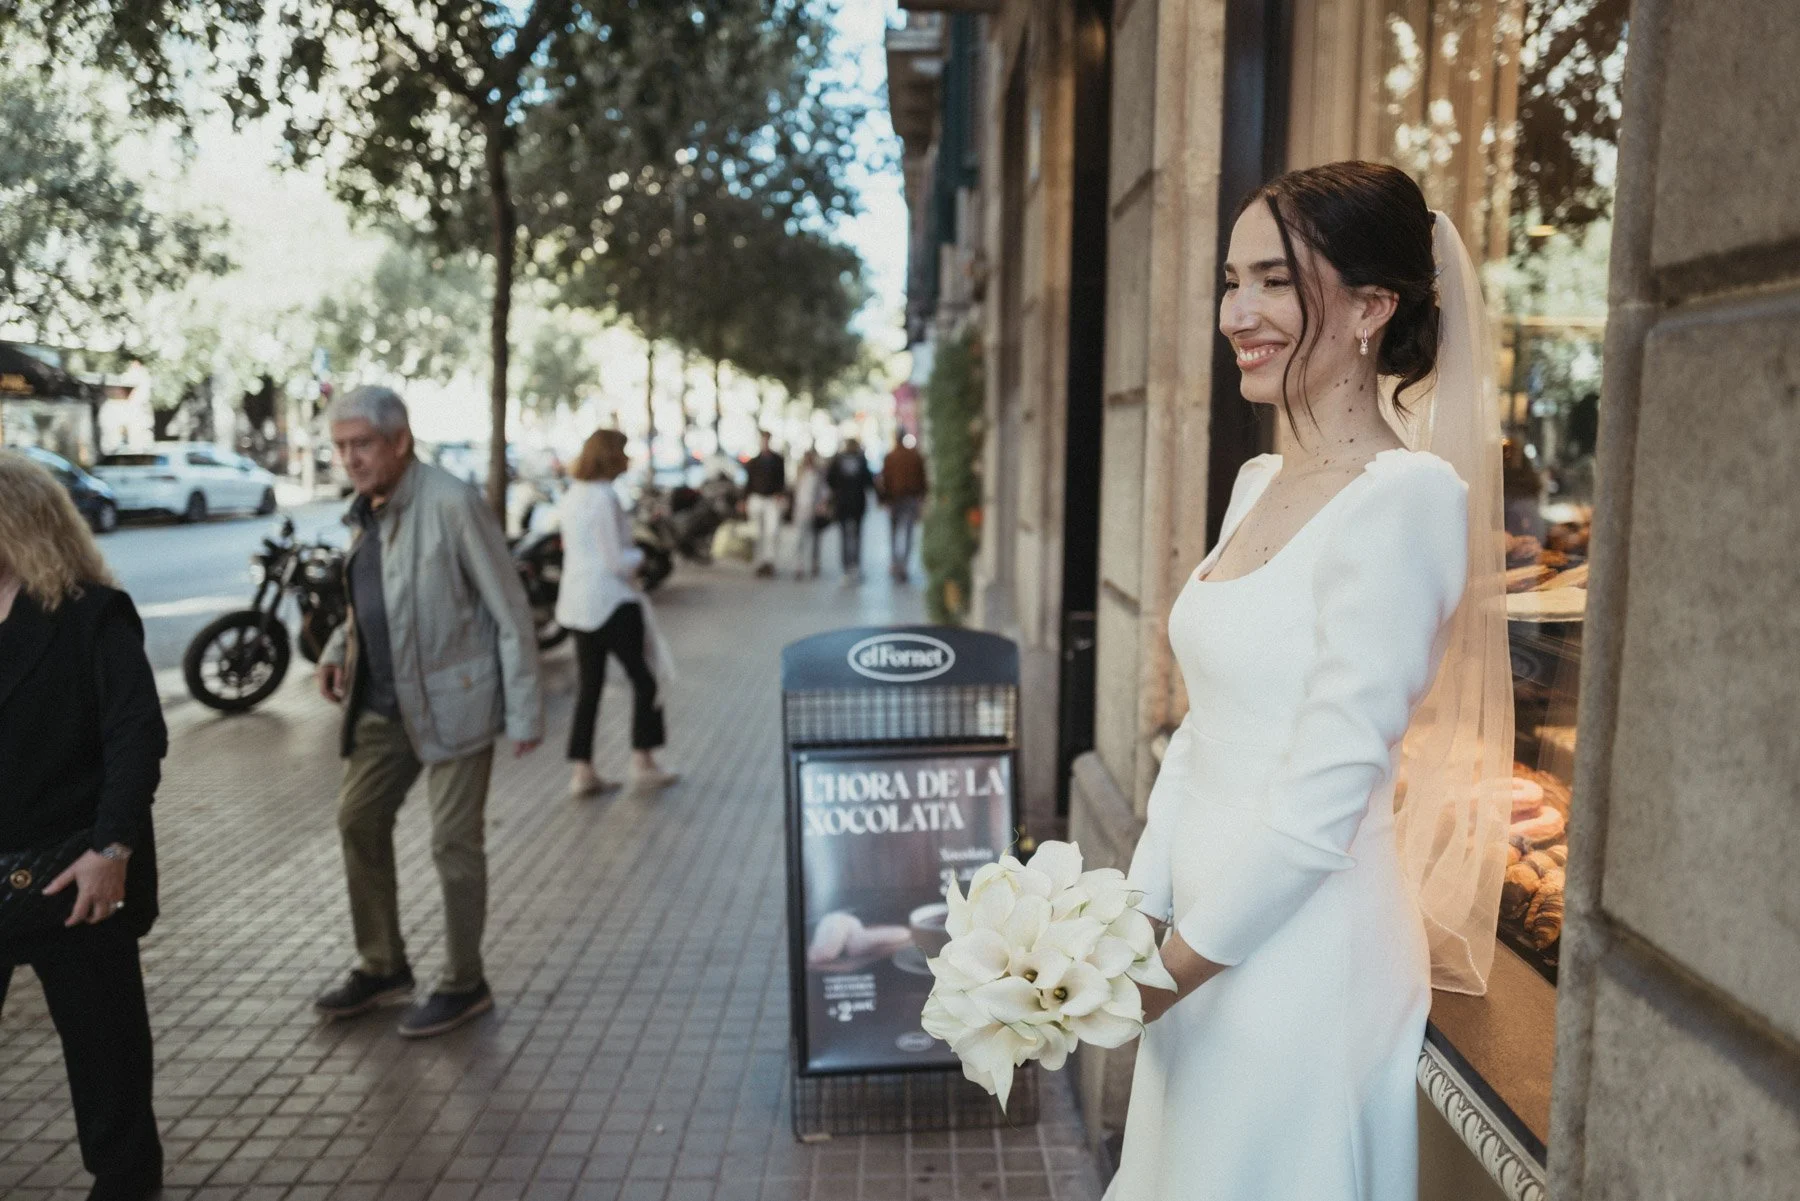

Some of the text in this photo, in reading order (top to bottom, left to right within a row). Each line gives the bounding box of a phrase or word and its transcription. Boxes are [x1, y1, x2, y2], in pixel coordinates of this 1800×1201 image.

[802, 766, 1005, 803] L'HORA DE LA
[803, 801, 965, 837] XOCOLATA
